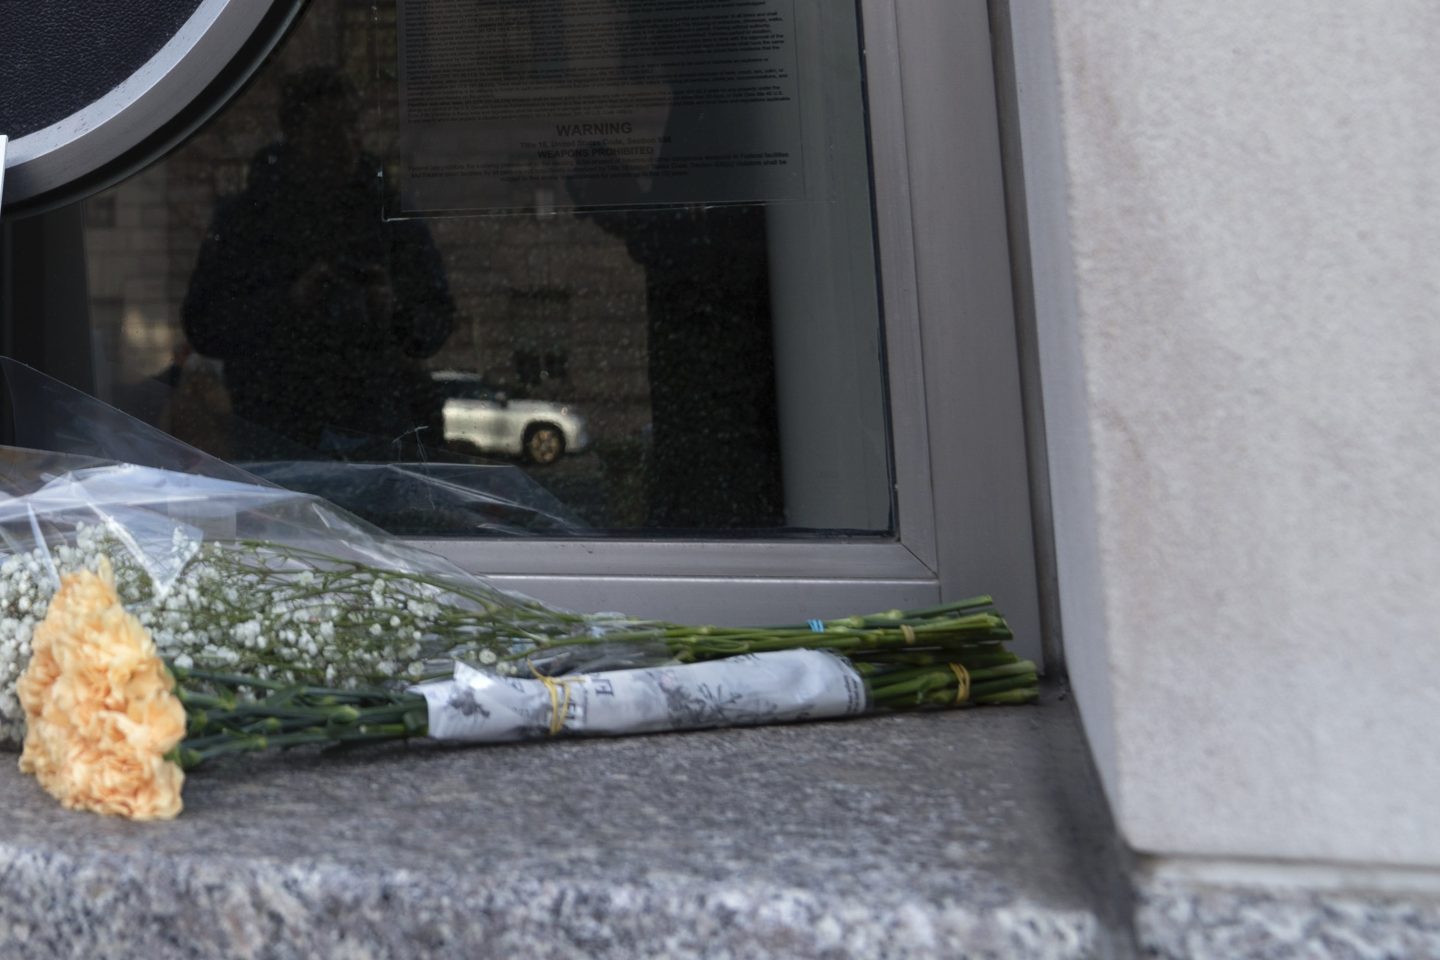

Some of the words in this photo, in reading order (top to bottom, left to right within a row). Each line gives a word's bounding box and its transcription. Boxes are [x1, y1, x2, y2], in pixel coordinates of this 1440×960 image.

[556, 122, 633, 137] WARNING
[537, 149, 588, 159] WEAPONS
[591, 146, 653, 157] PROHIBITED
